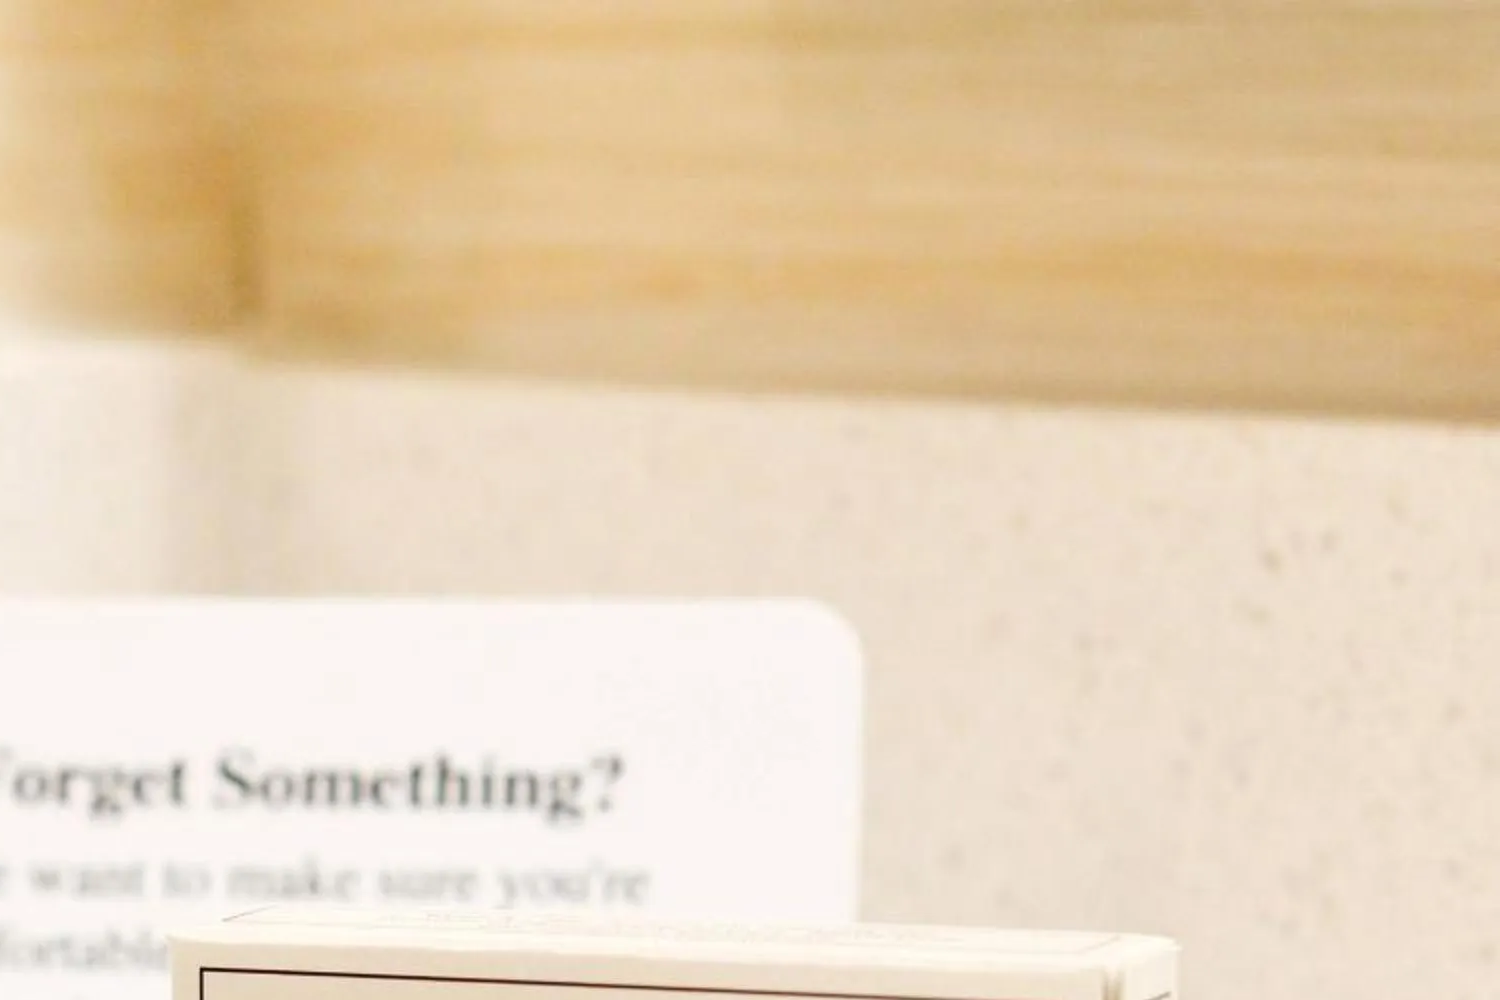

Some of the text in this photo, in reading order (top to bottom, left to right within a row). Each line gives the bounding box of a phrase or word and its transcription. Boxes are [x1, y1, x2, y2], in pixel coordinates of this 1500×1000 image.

[212, 748, 628, 825] Something?
[29, 857, 143, 899] want
[163, 856, 211, 899] to
[226, 852, 356, 901] make
[378, 864, 479, 901] sure
